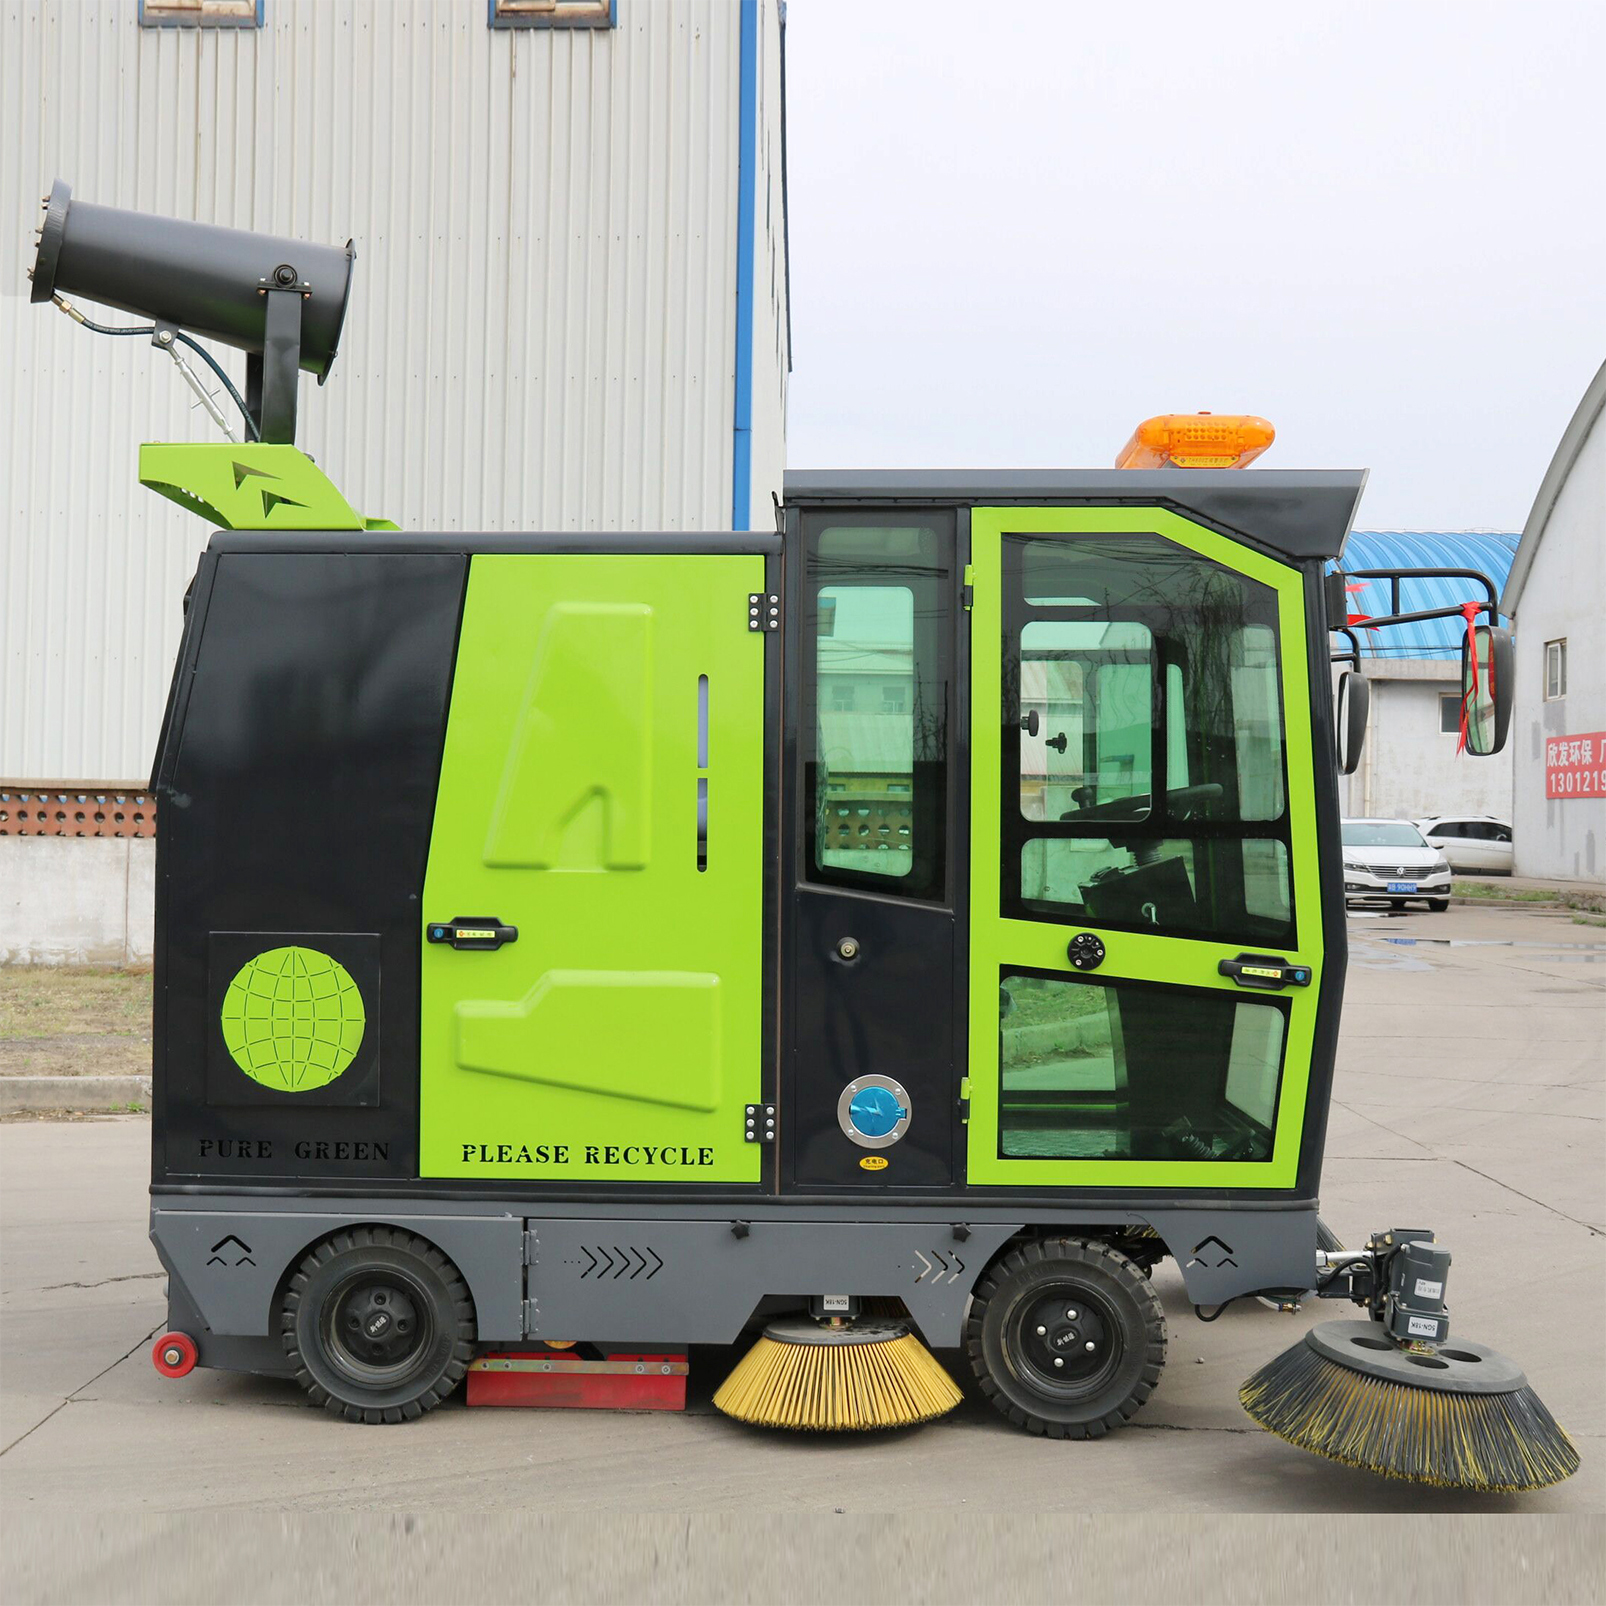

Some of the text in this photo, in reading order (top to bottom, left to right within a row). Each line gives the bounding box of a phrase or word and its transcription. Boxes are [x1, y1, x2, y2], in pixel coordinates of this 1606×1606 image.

[1550, 770, 1606, 793] 1301219
[198, 1139, 390, 1161] PURE GREEN
[461, 1144, 715, 1166] PLEASE RECYCLE
[1411, 1321, 1436, 1331] 5GN-18K
